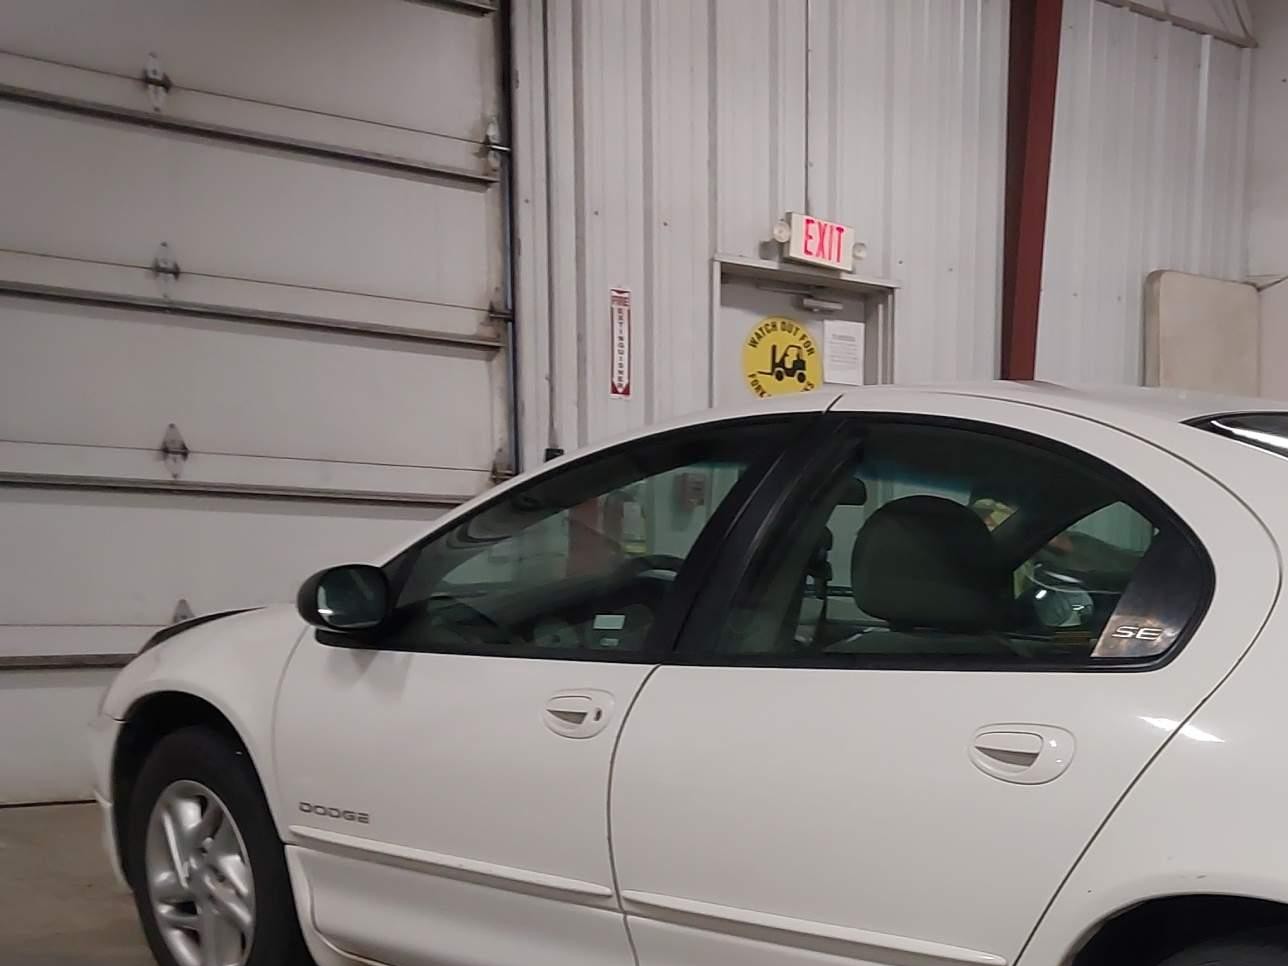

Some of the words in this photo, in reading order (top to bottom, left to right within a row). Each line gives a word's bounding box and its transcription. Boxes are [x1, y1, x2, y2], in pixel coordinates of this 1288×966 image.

[803, 218, 844, 263] EXIT
[616, 307, 625, 389] EXTINGUISHER
[748, 321, 779, 349] WATCH
[780, 321, 800, 337] OUT
[800, 334, 816, 356] FOR
[1111, 625, 1163, 641] SE
[299, 801, 369, 824] DODGE
